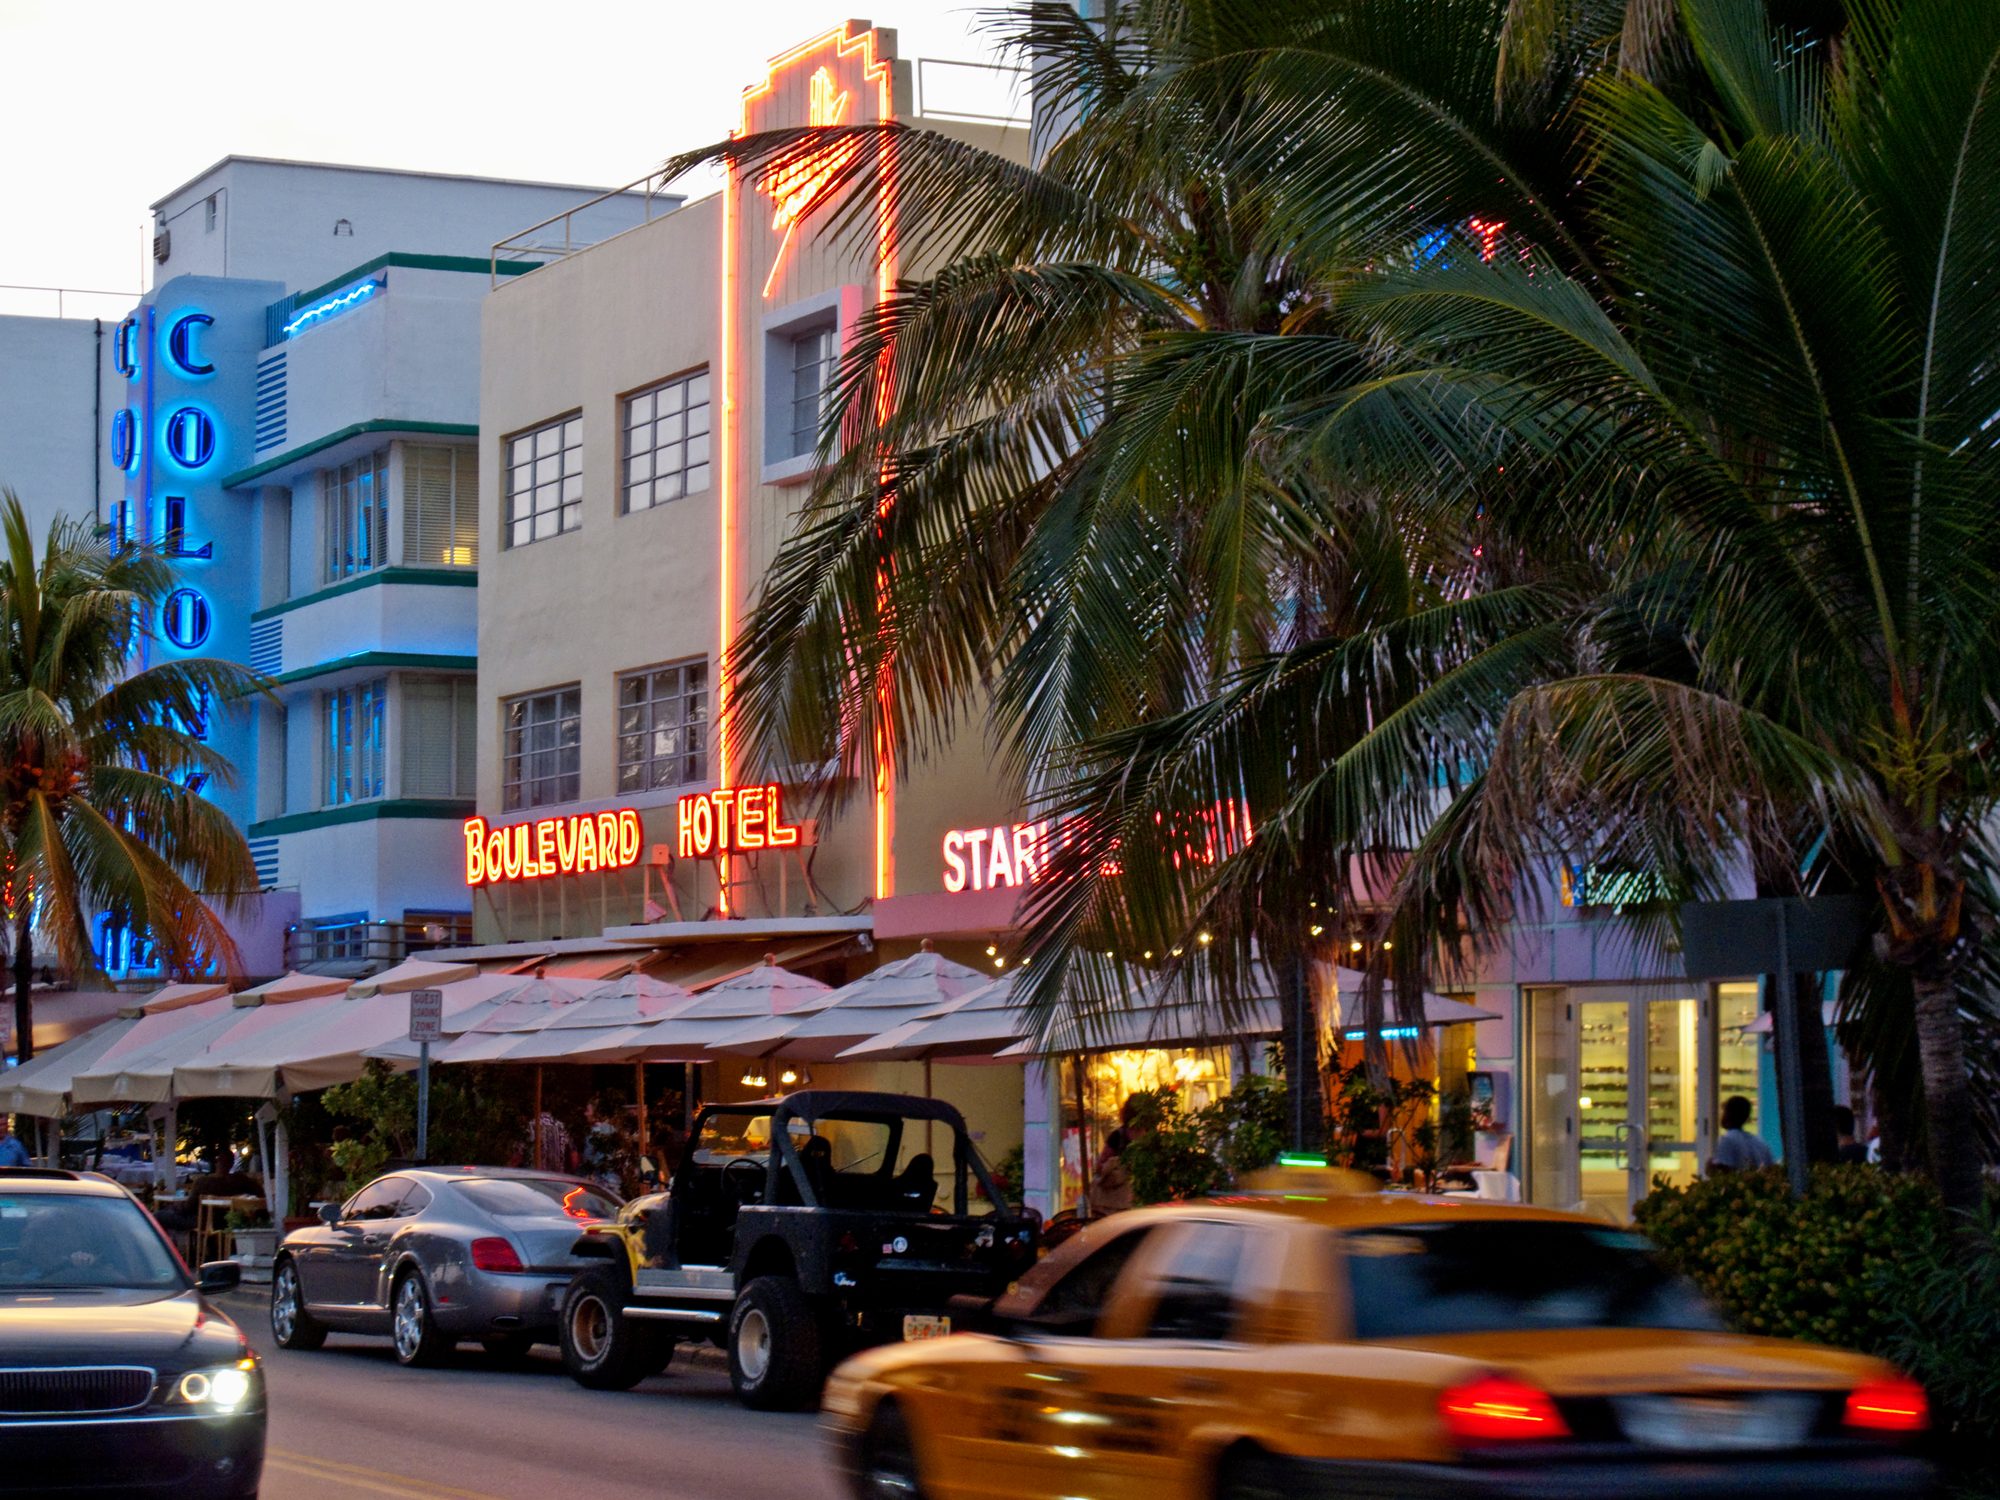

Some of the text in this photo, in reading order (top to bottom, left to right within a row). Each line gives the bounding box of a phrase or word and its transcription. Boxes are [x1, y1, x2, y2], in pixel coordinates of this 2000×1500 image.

[163, 312, 215, 815] COLO
[464, 782, 799, 886] BOULEVARD HOTEL
[414, 993, 439, 1005] GUEST
[415, 1021, 437, 1031] ZONE
